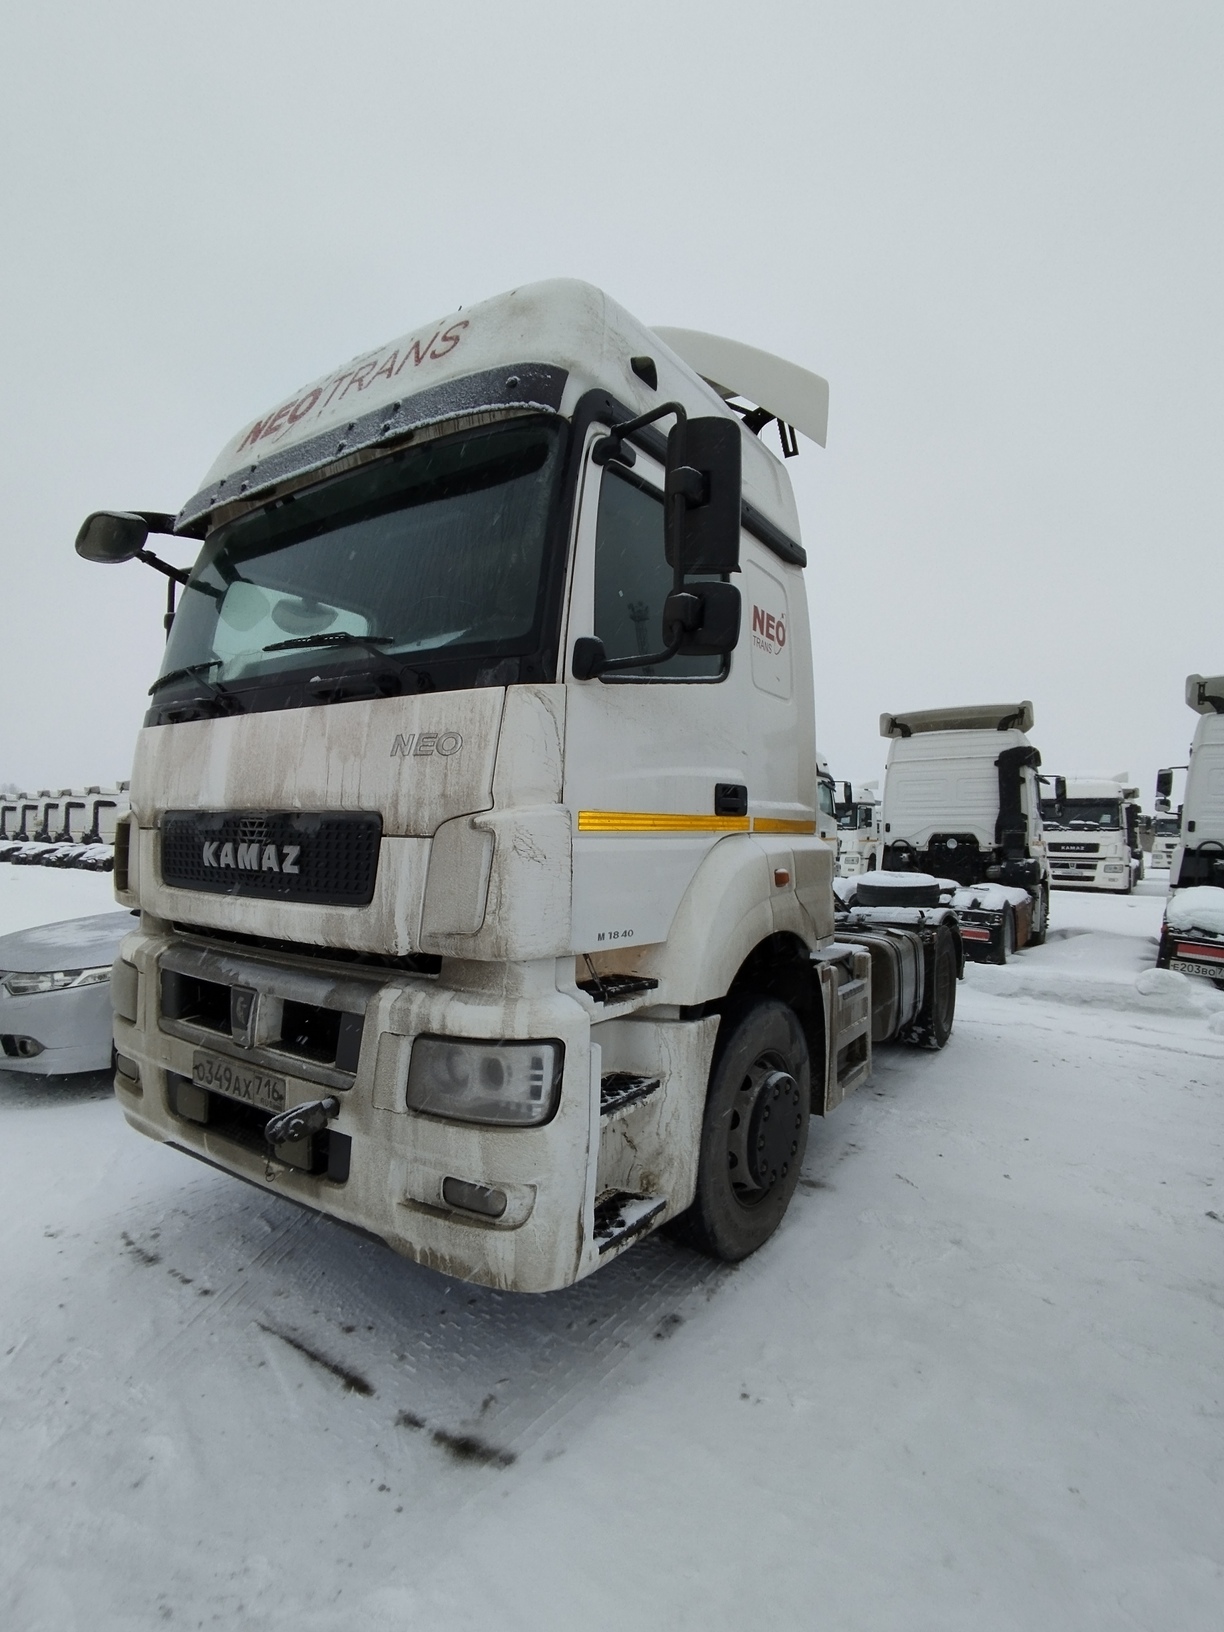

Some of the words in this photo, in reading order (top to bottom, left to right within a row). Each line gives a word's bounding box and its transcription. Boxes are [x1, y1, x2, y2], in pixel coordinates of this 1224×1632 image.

[236, 387, 323, 453] NEO
[323, 320, 469, 408] TRANS
[752, 604, 786, 647] NEO
[752, 634, 773, 655] TRANS
[390, 731, 463, 757] NEO
[202, 840, 301, 875] KAMAZ
[597, 932, 605, 942] M
[254, 1075, 281, 1103] 716
